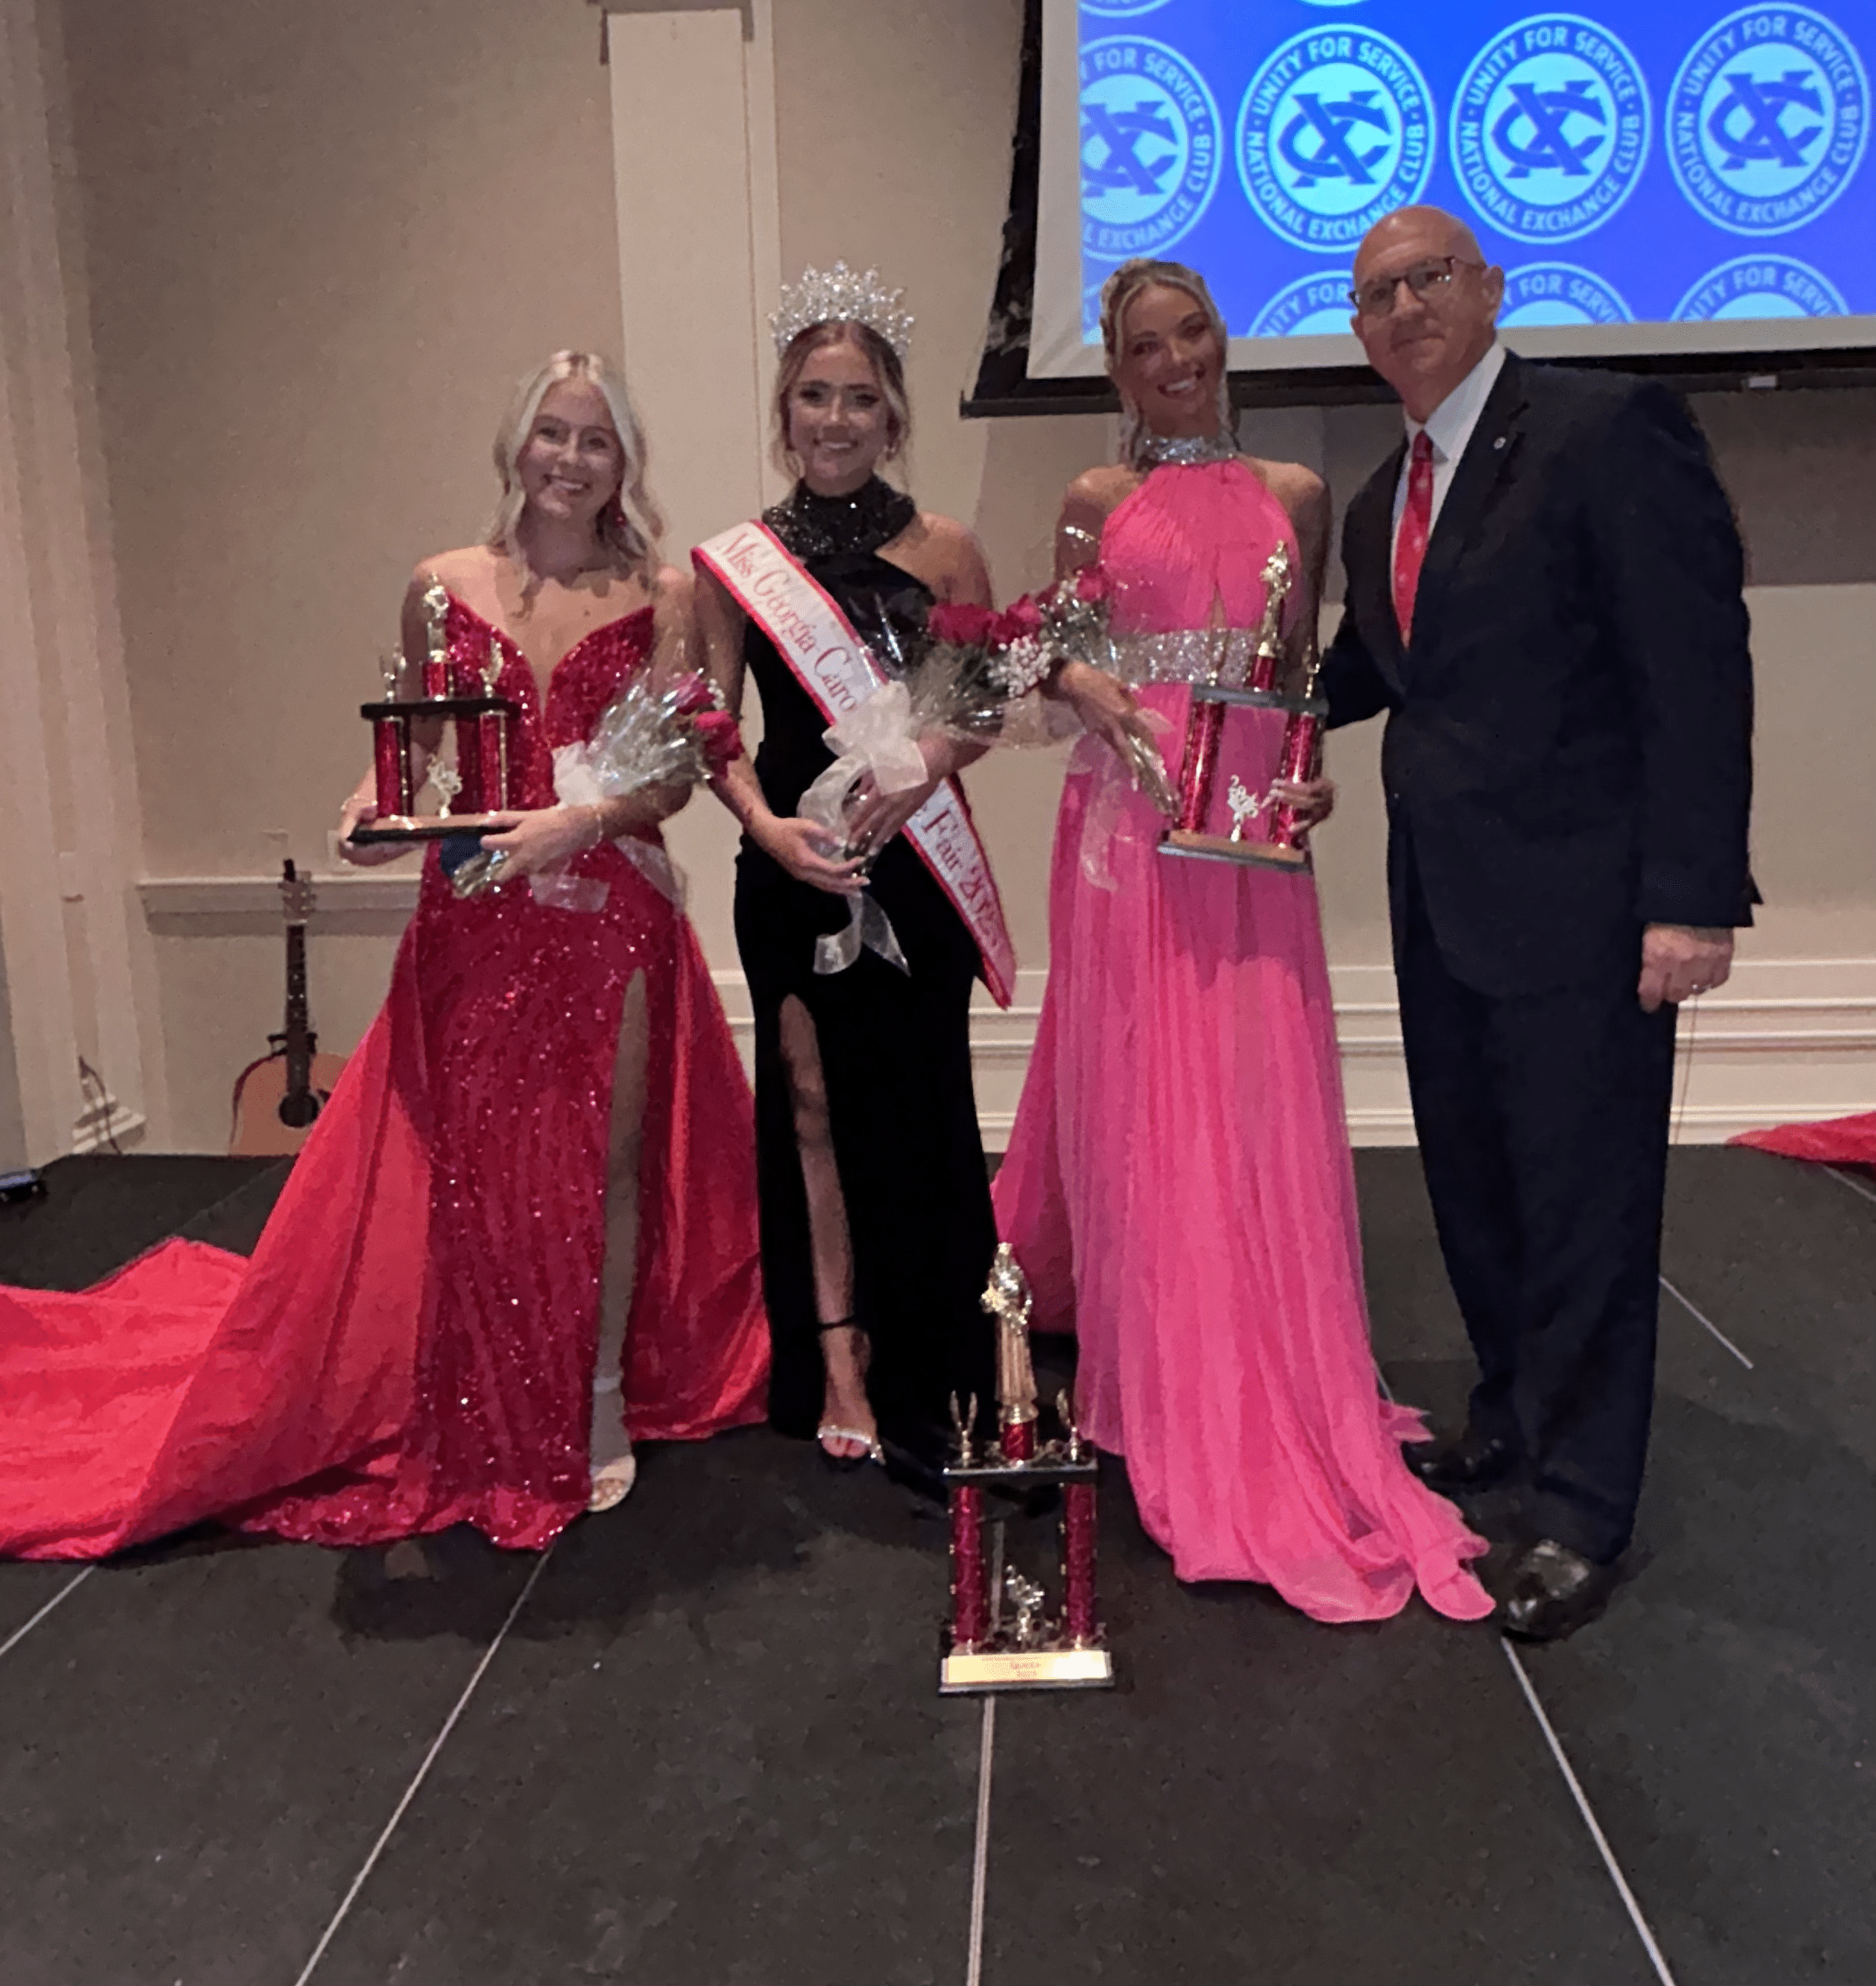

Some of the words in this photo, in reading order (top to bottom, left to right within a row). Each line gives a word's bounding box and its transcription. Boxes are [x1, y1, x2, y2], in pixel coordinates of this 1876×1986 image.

[1094, 47, 1138, 72] FOR
[1143, 52, 1206, 122] SERVICE
[1252, 48, 1303, 115] UNITY
[1307, 36, 1352, 62] FOR
[1357, 41, 1420, 112] SERVICE
[1467, 39, 1518, 106] UNITY
[1524, 26, 1568, 52] FOR
[1574, 30, 1637, 102] SERVICE
[1683, 28, 1736, 96] UNITY
[1742, 14, 1787, 41] FOR
[1792, 20, 1855, 92] SERVICE
[1097, 194, 1195, 250] EXCHANGE
[1186, 134, 1211, 192] CLUB
[1247, 131, 1305, 233] NATIONAL
[1308, 185, 1407, 240] EXCHANGE
[1398, 123, 1425, 182] CLUB
[1461, 120, 1517, 224] NATIONAL
[1521, 175, 1621, 231] EXCHANGE
[1613, 115, 1640, 173] CLUB
[1676, 112, 1734, 216] NATIONAL
[1735, 166, 1838, 223] EXCHANGE
[1830, 105, 1860, 166] CLUB
[1306, 283, 1350, 306] FOR
[1519, 273, 1563, 298] FOR
[1732, 267, 1776, 290] FOR
[715, 532, 760, 579] Miss
[753, 569, 818, 655] Georgia
[921, 808, 962, 870] Fair
